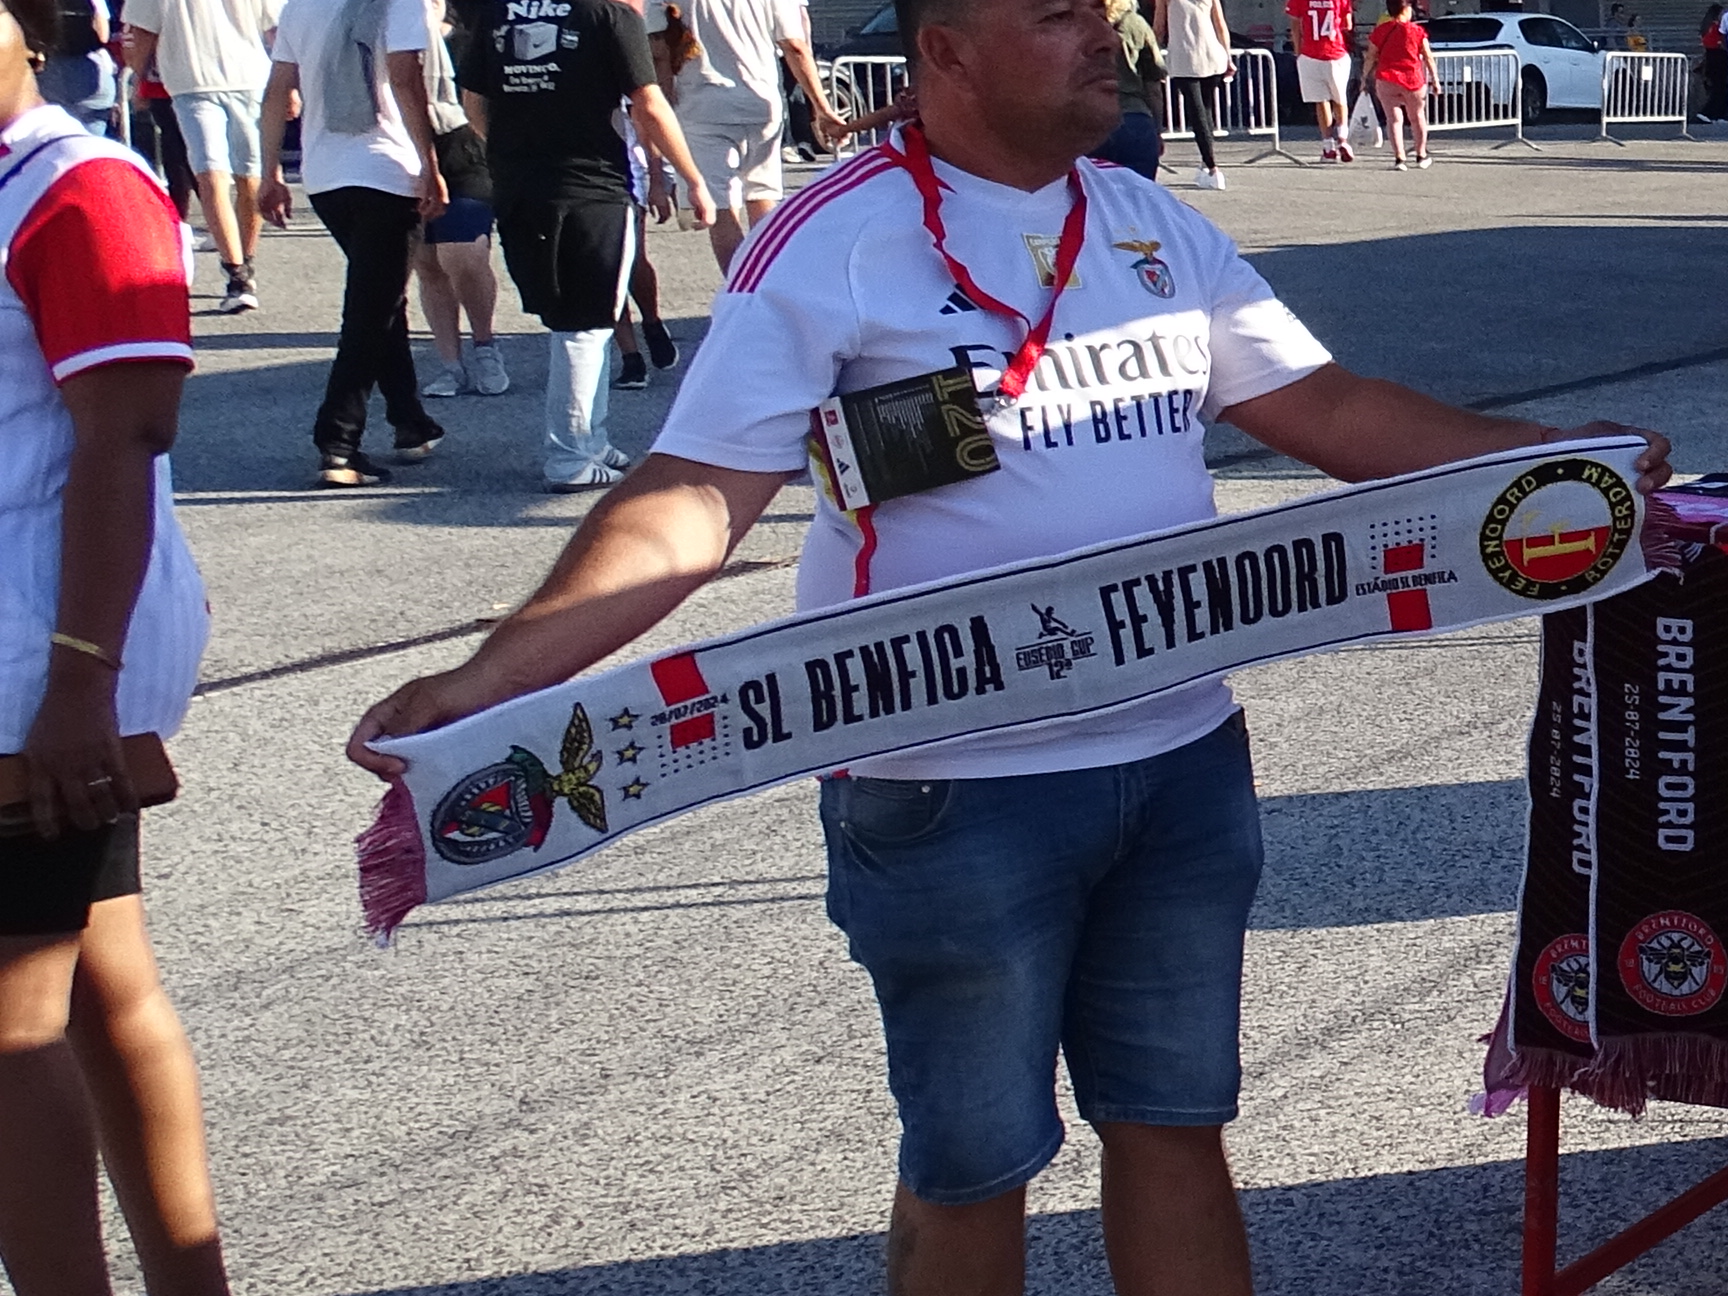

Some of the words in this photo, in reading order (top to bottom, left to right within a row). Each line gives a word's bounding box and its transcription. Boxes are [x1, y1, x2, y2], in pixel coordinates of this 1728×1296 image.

[506, 0, 571, 20] Nike
[1307, 10, 1336, 40] 14
[949, 330, 1210, 402] Emirates
[1020, 402, 1074, 451] FLY
[1089, 389, 1195, 444] BETTER
[1483, 474, 1540, 597] FEYENOORD
[1579, 464, 1632, 584] ROTTERDAM
[738, 671, 792, 750] SL
[804, 615, 1005, 733] BENFICA
[1099, 531, 1348, 667] FEYENOORD
[1623, 683, 1641, 782] 25-07-2024
[1656, 616, 1695, 852] BRENTFORD
[1550, 939, 1588, 959] BRENT
